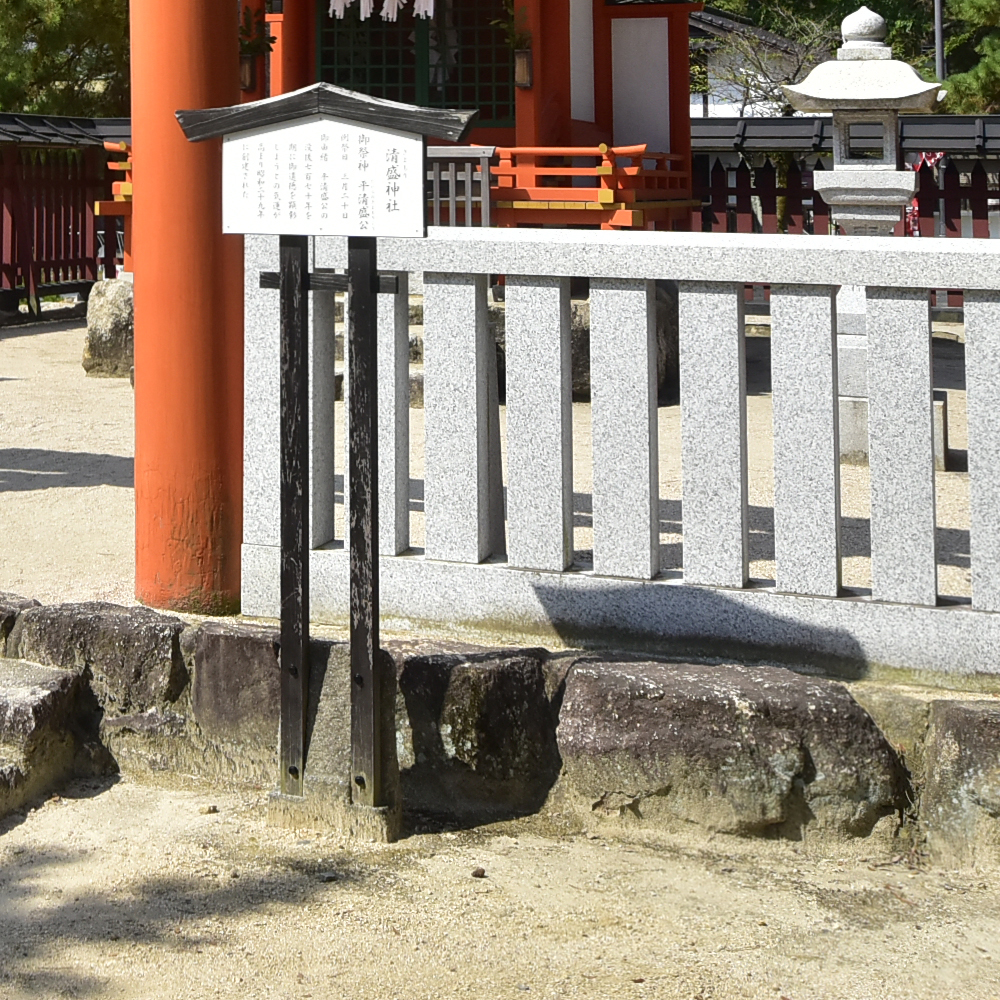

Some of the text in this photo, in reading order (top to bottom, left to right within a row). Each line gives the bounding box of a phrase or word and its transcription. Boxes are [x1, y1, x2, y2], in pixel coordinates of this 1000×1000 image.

[319, 172, 329, 219] 平清盛公の
[340, 133, 350, 219] 例祭日 三月二十日
[357, 133, 370, 230] 御祭神 平清盛公
[385, 147, 402, 213] 清盛神社
